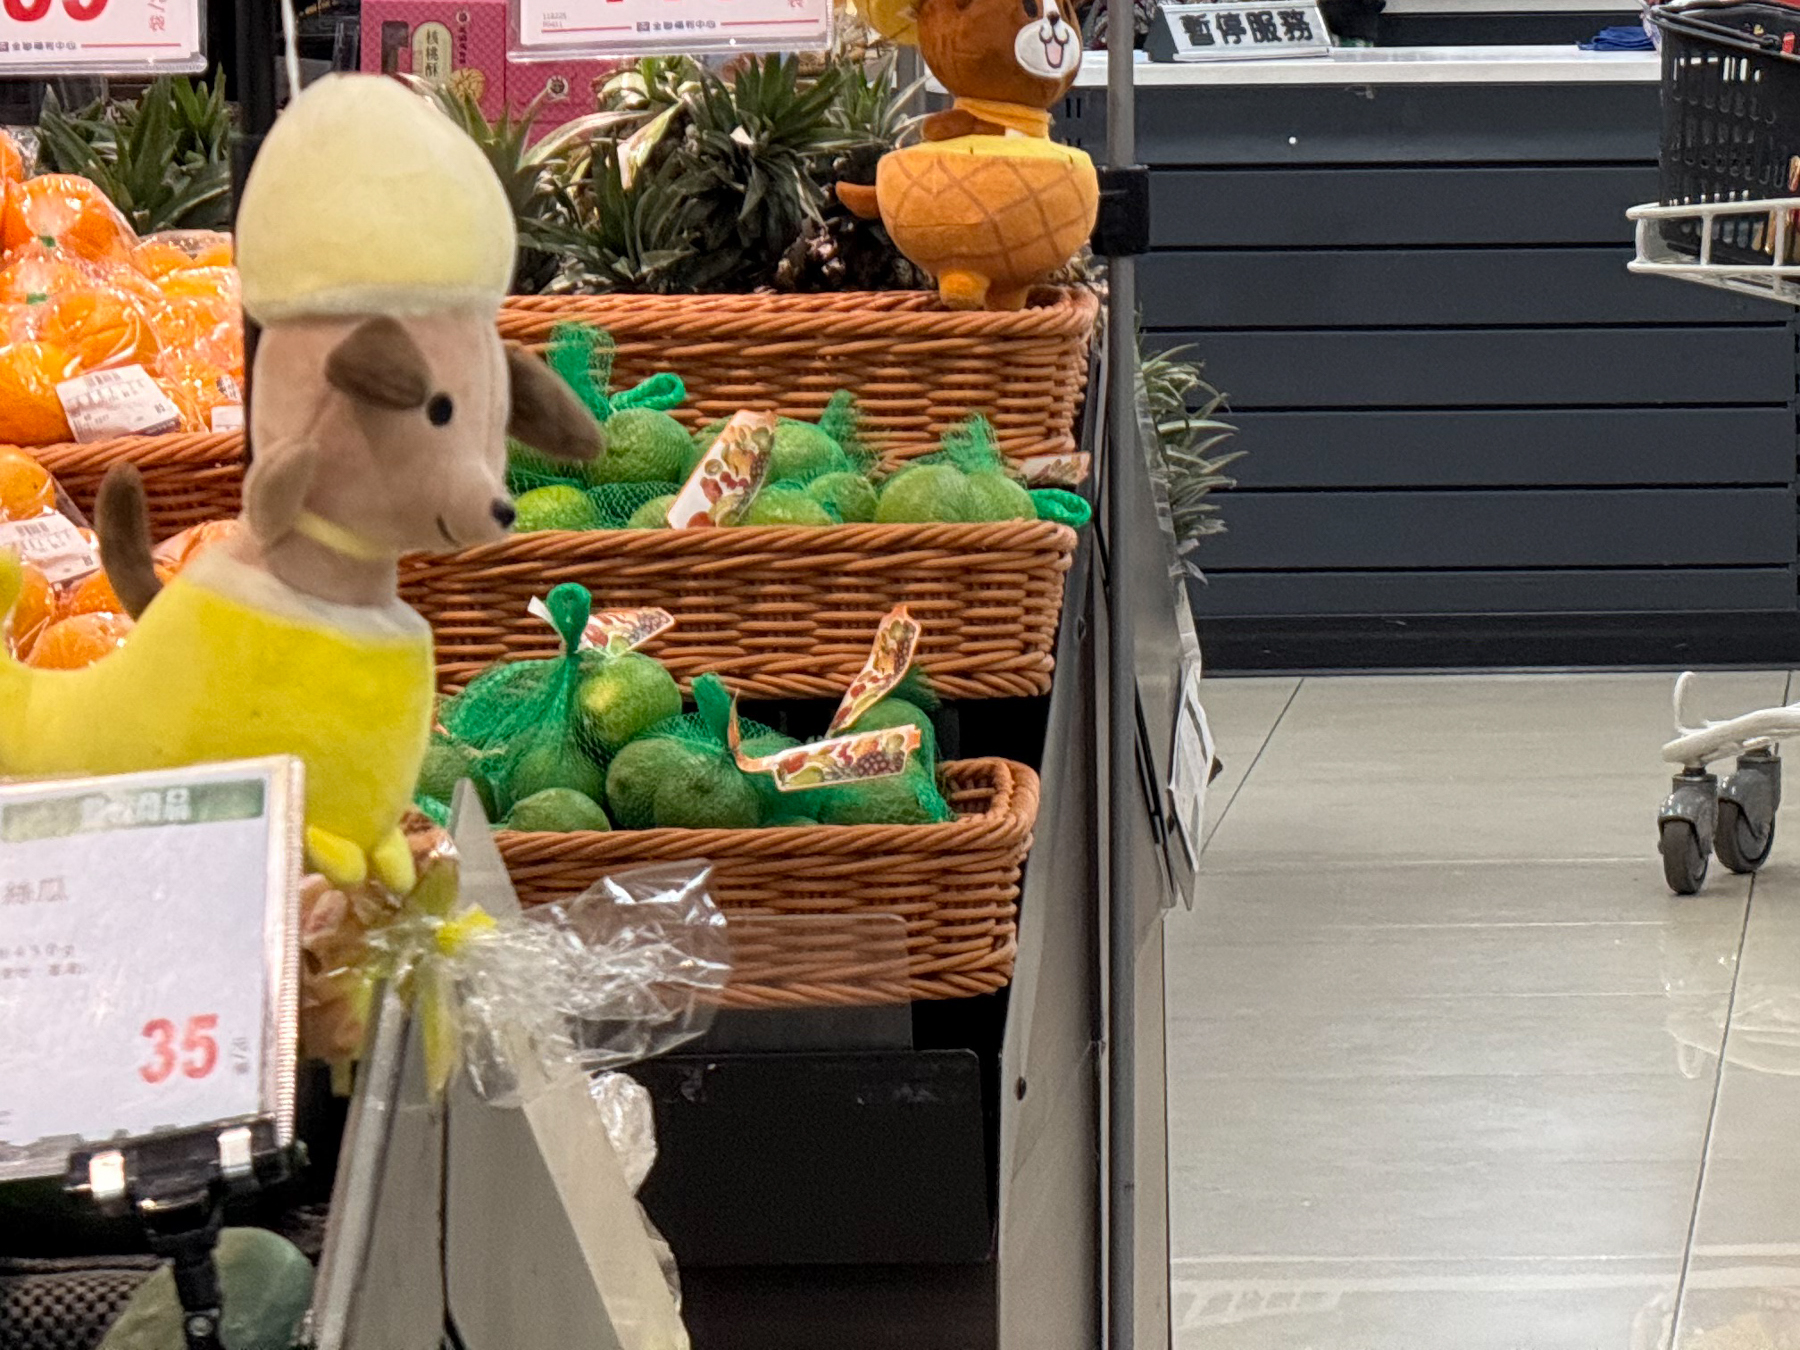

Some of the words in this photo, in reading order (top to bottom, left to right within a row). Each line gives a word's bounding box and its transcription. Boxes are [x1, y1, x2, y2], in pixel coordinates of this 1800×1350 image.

[1182, 10, 1313, 44] 暫停服務
[139, 1013, 220, 1084] 35
